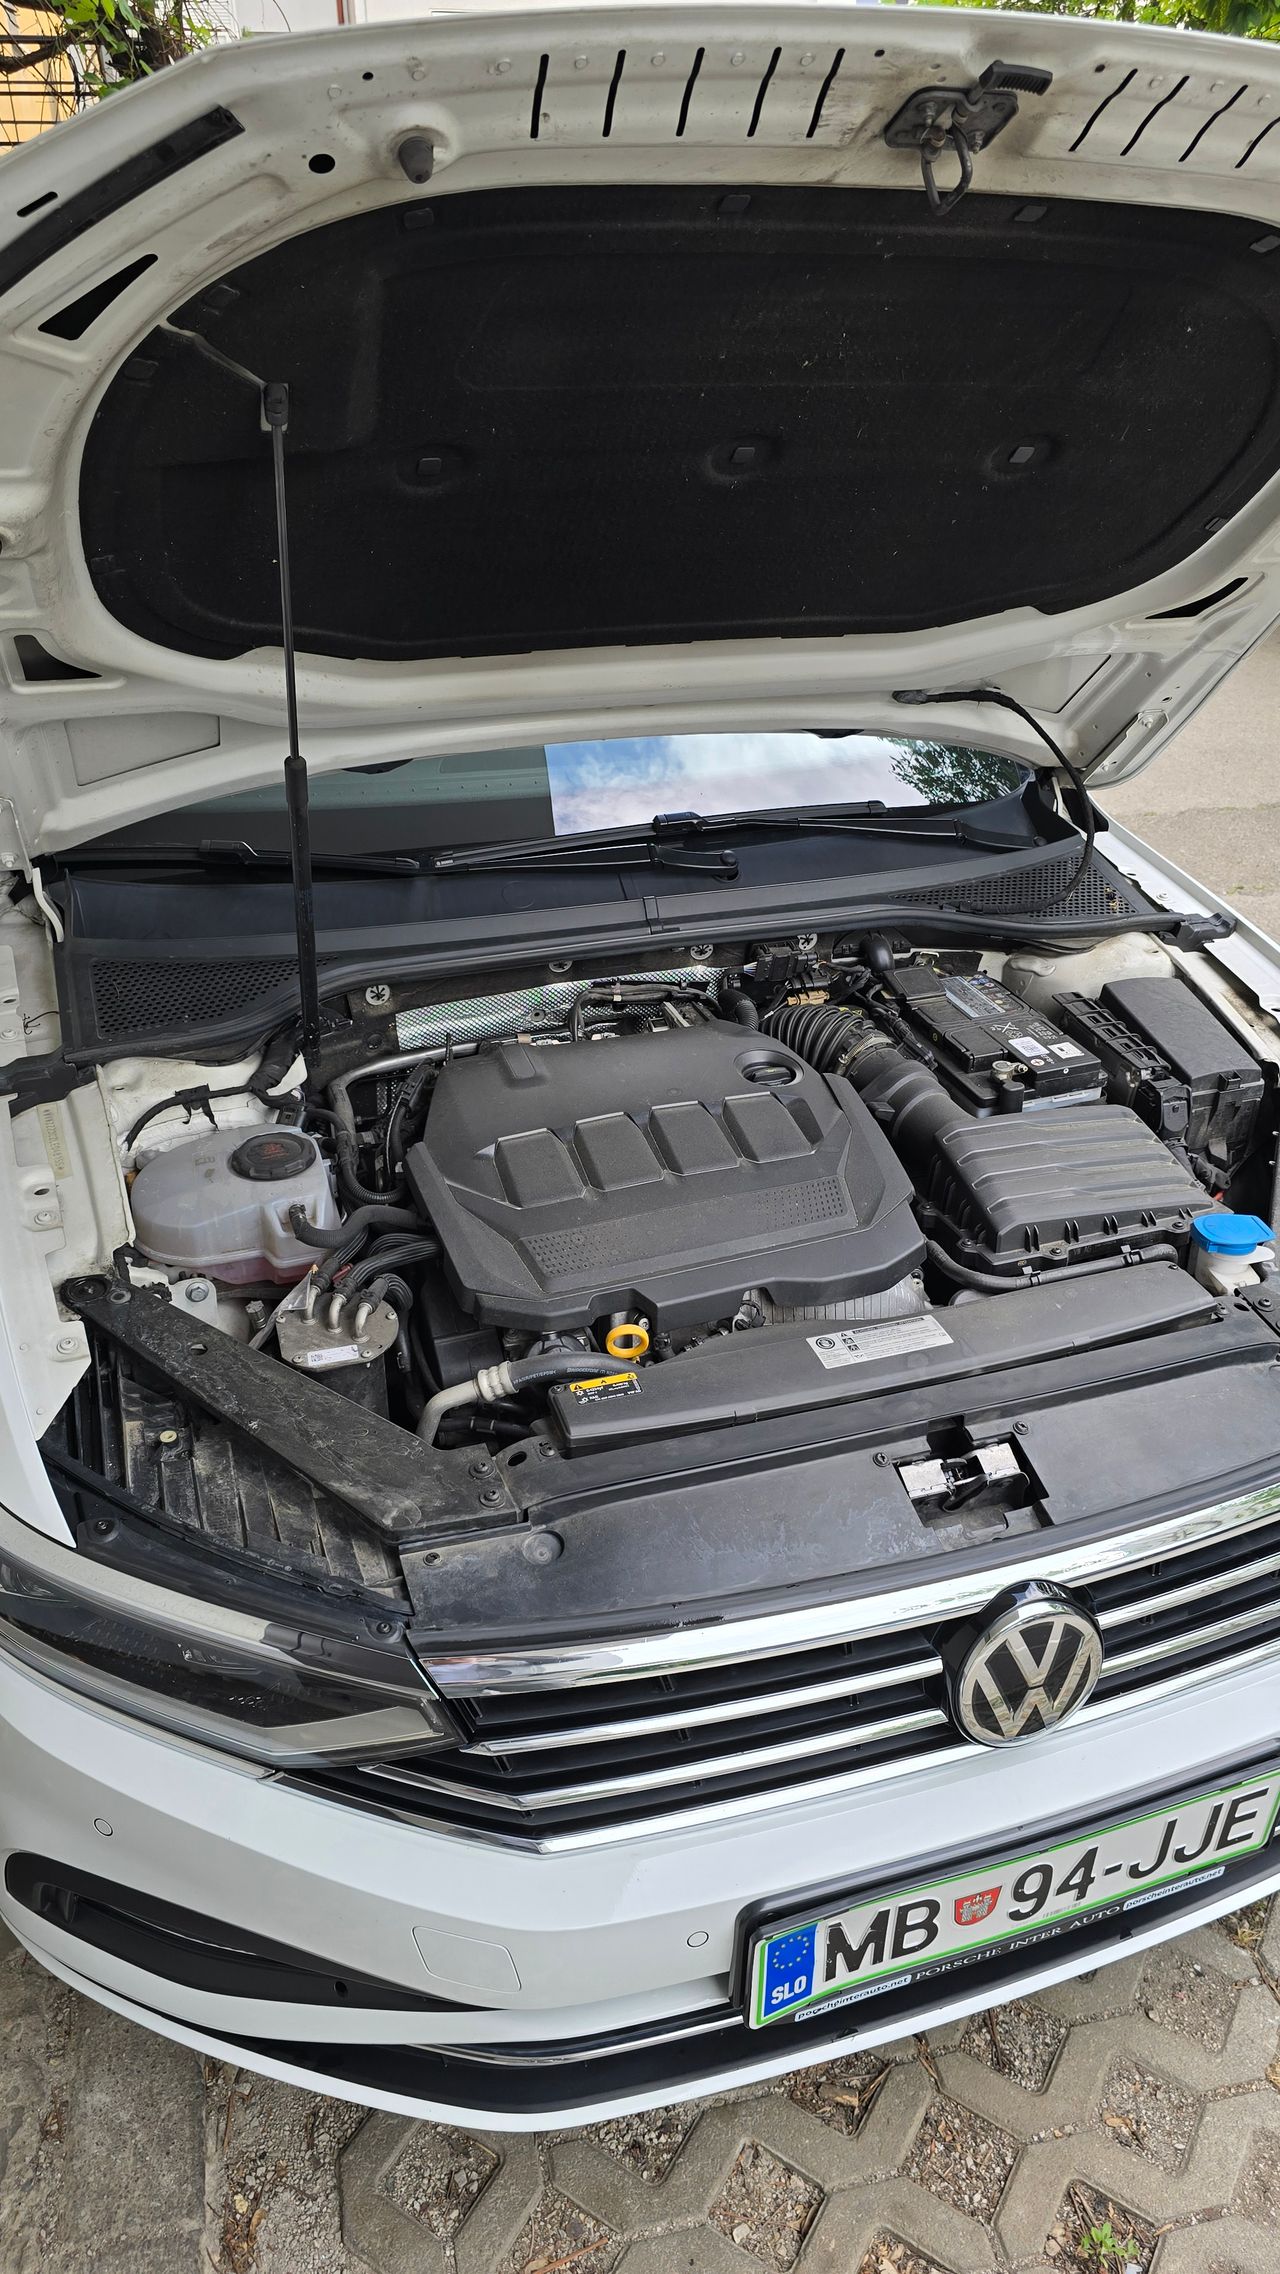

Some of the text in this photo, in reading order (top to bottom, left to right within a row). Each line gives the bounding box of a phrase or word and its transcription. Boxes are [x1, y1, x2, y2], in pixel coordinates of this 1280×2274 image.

[962, 1614, 1101, 1742] VW
[824, 1787, 1269, 1982] MB 94-JJE
[915, 1947, 1002, 1980] PORSCHE
[1009, 1926, 1062, 1950] INTER
[1069, 1905, 1120, 1929] AUTO
[1125, 1868, 1222, 1908] porscheinterauto.net
[771, 1975, 807, 2006] SLO
